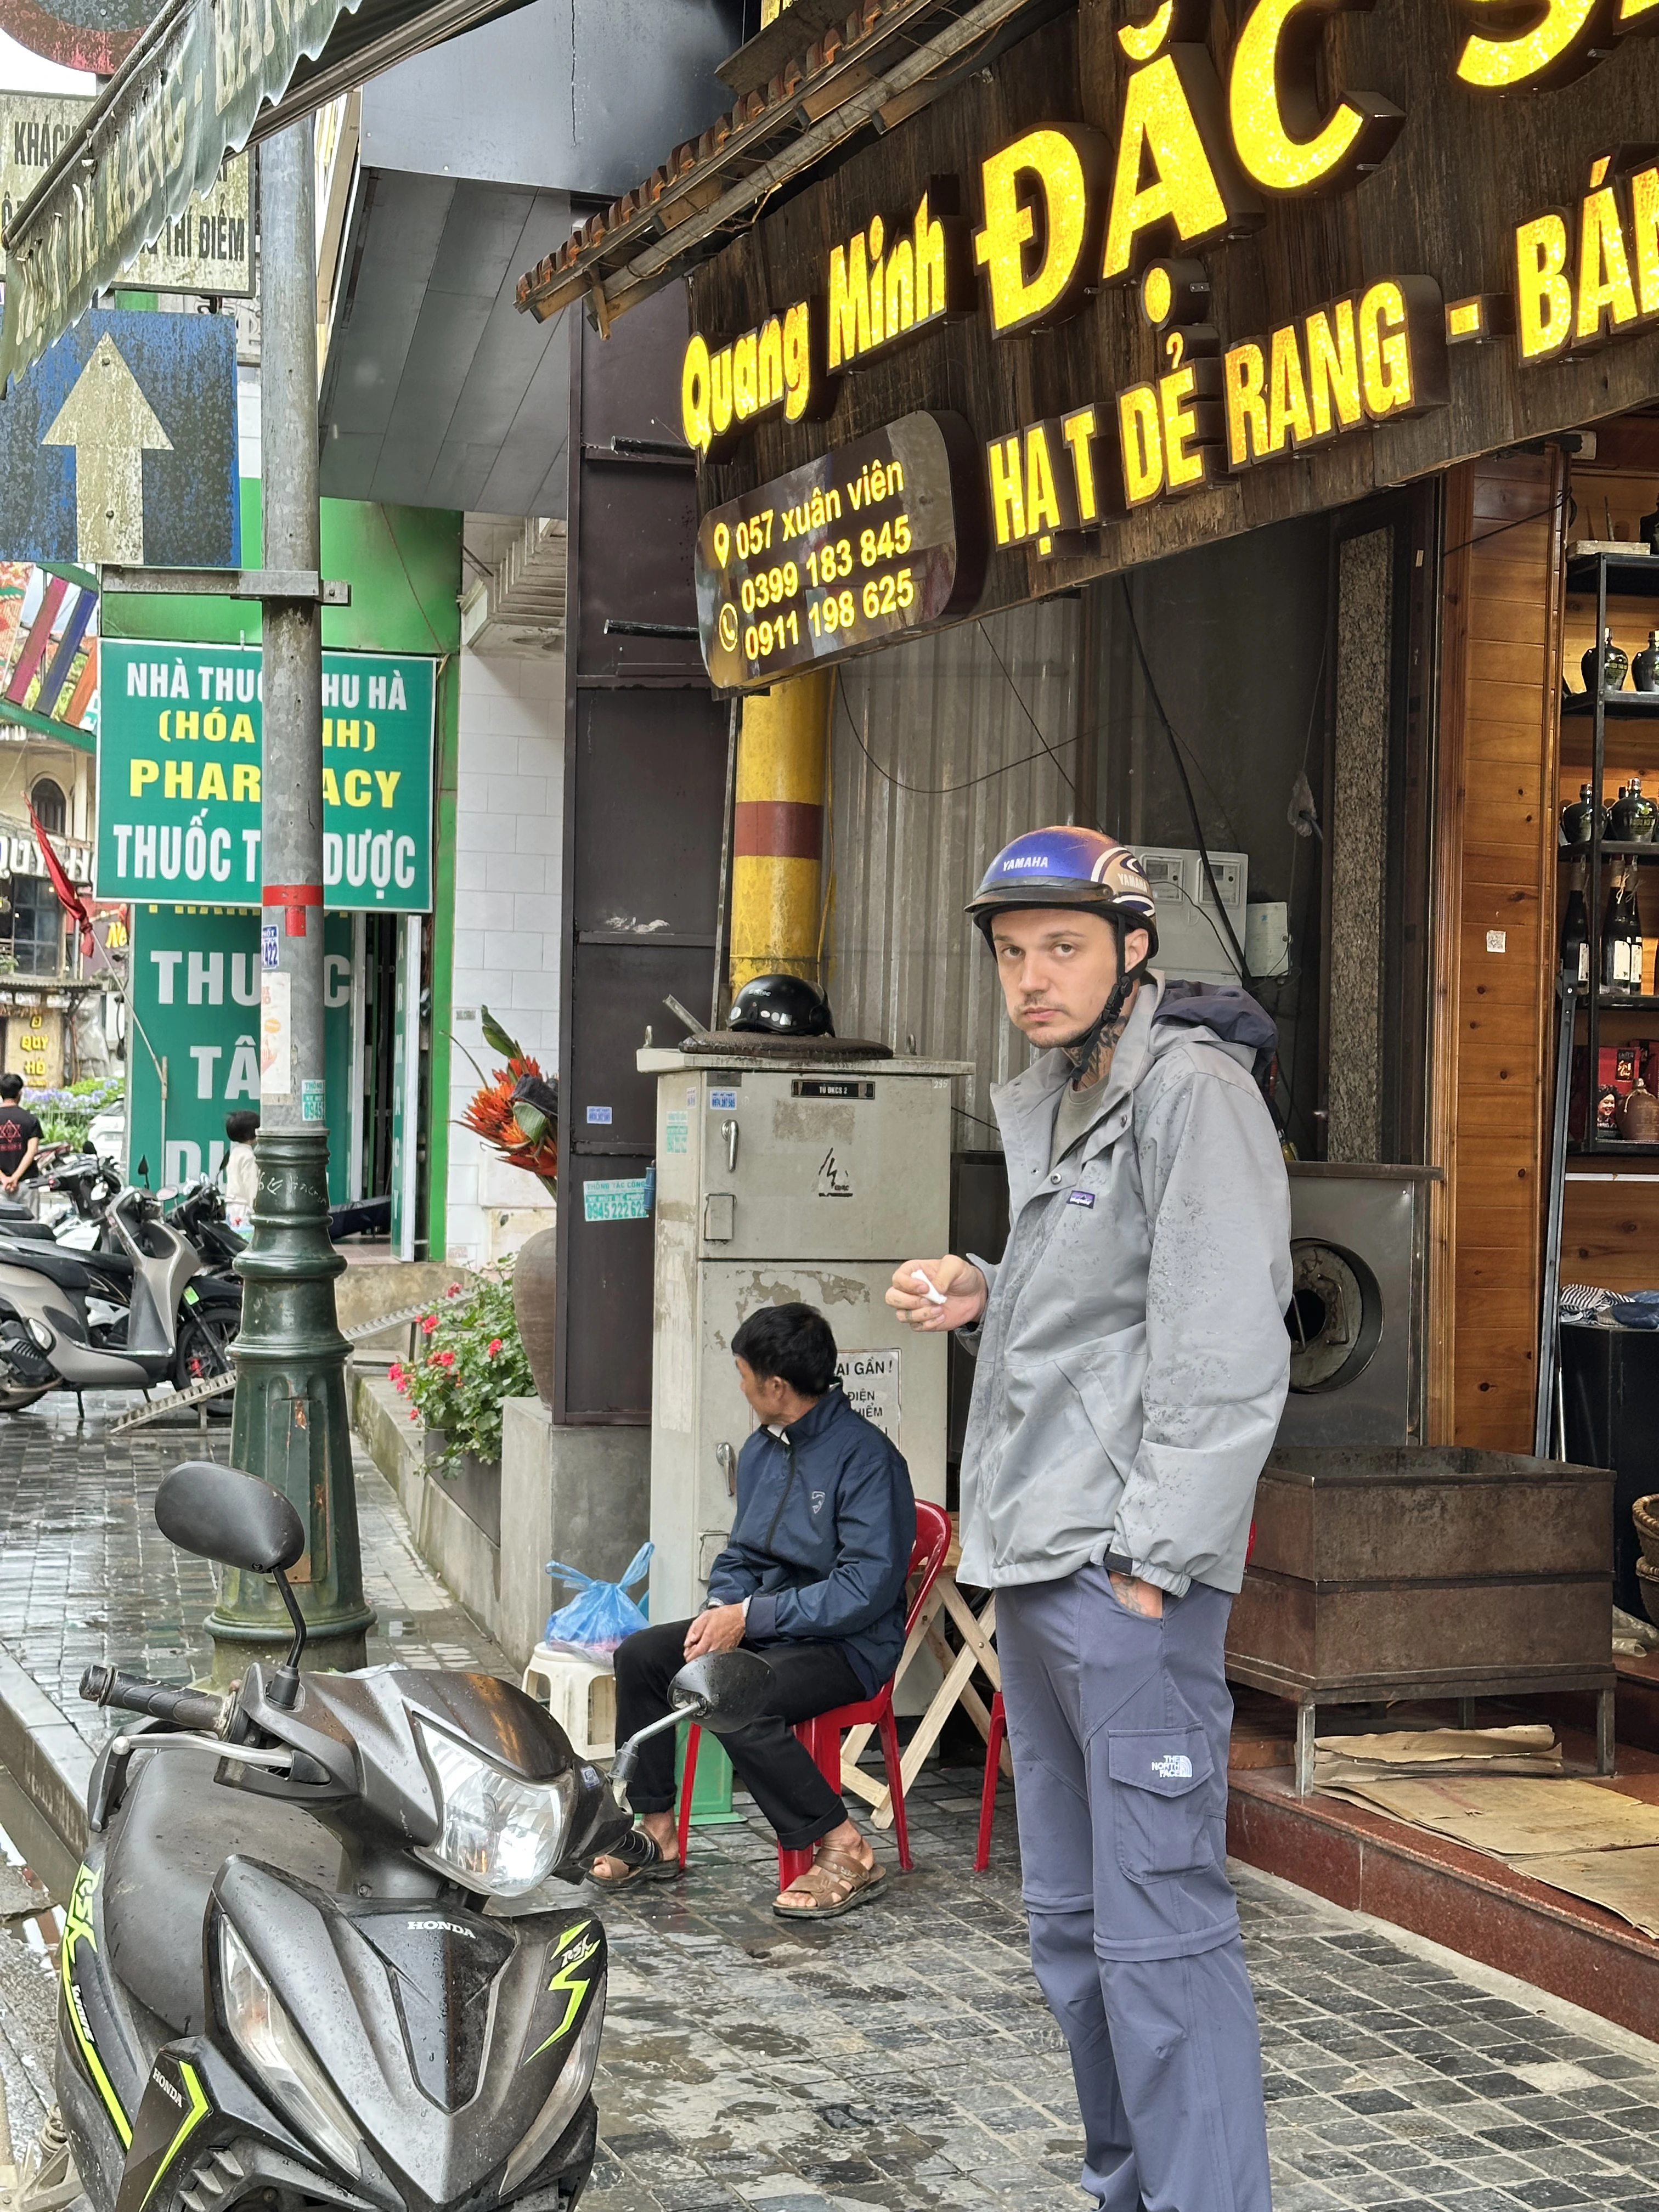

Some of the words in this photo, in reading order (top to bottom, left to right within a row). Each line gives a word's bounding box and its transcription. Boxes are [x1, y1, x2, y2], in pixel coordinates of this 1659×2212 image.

[976, 0, 1363, 329] ĐẶC
[199, 193, 245, 261] ĐIỂM
[682, 301, 810, 455] Quang
[828, 190, 945, 369] Minh
[989, 410, 1096, 555] HẠT
[1119, 331, 1204, 503] DẺ
[1224, 281, 1413, 464] RANG
[736, 509, 774, 560] 057
[781, 487, 842, 542] xuân
[847, 459, 904, 511] viên
[741, 561, 798, 613] 0399
[806, 539, 853, 588] 183
[860, 514, 911, 567] 845
[745, 610, 799, 660] 0911
[809, 590, 855, 637] 198
[862, 568, 914, 619] 625
[127, 657, 190, 699] NHÀ
[198, 666, 263, 703] THU
[322, 673, 359, 708] HU
[368, 669, 407, 710] HÀ
[159, 706, 256, 743] (HÓA
[130, 759, 401, 808] PHARACY
[113, 808, 231, 882] THUỐC
[323, 828, 415, 899] DƯỢC
[1003, 856, 1048, 871] YAMAHA
[1117, 873, 1148, 893] YAMAHA
[150, 950, 351, 1008] THUC
[190, 1035, 261, 1099] TÂ
[392, 930, 404, 1219] ARMACY
[304, 1102, 324, 1119] 0945
[854, 1356, 884, 1375] GẦN
[855, 1402, 883, 1418] IỂM
[1152, 1762, 1180, 1771] NORTH
[407, 1921, 476, 1939] HONDA
[153, 2067, 182, 2108] HONDA
